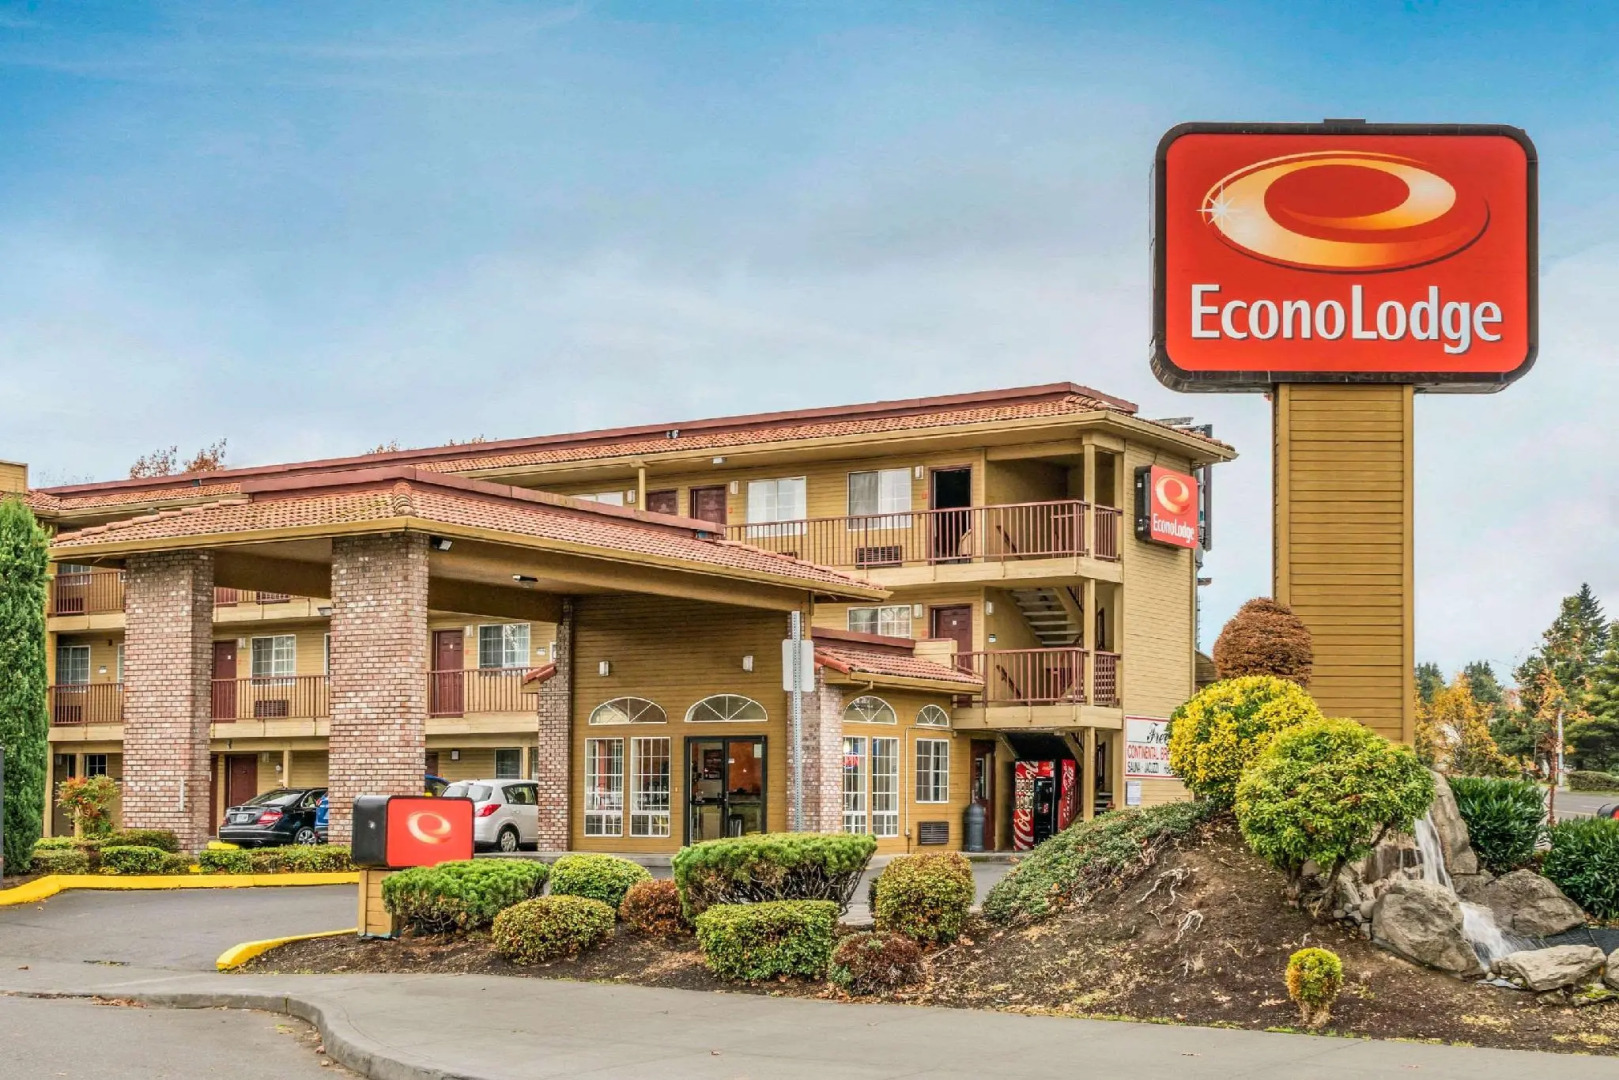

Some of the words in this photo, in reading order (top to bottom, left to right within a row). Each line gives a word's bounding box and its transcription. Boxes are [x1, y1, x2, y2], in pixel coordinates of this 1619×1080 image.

[1191, 283, 1503, 354] EconoLodge
[1152, 513, 1195, 544] EconoLodge
[1127, 744, 1159, 760] CONTINENTAL
